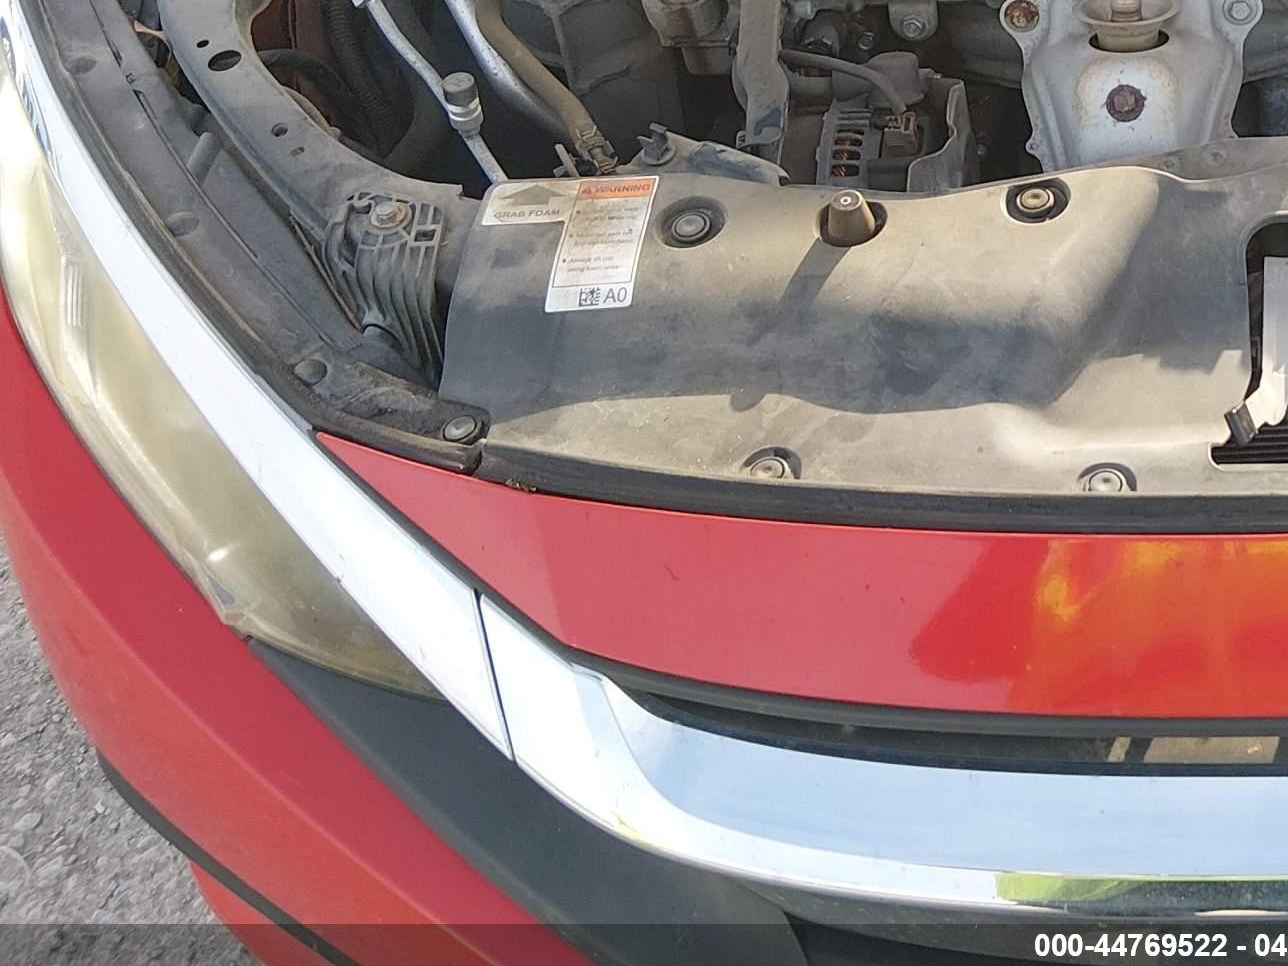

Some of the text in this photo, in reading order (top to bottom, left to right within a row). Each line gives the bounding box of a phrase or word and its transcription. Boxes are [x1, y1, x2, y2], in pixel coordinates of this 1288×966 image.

[595, 183, 651, 194] WARNING
[528, 209, 560, 217] FOAM
[603, 287, 628, 304] A0
